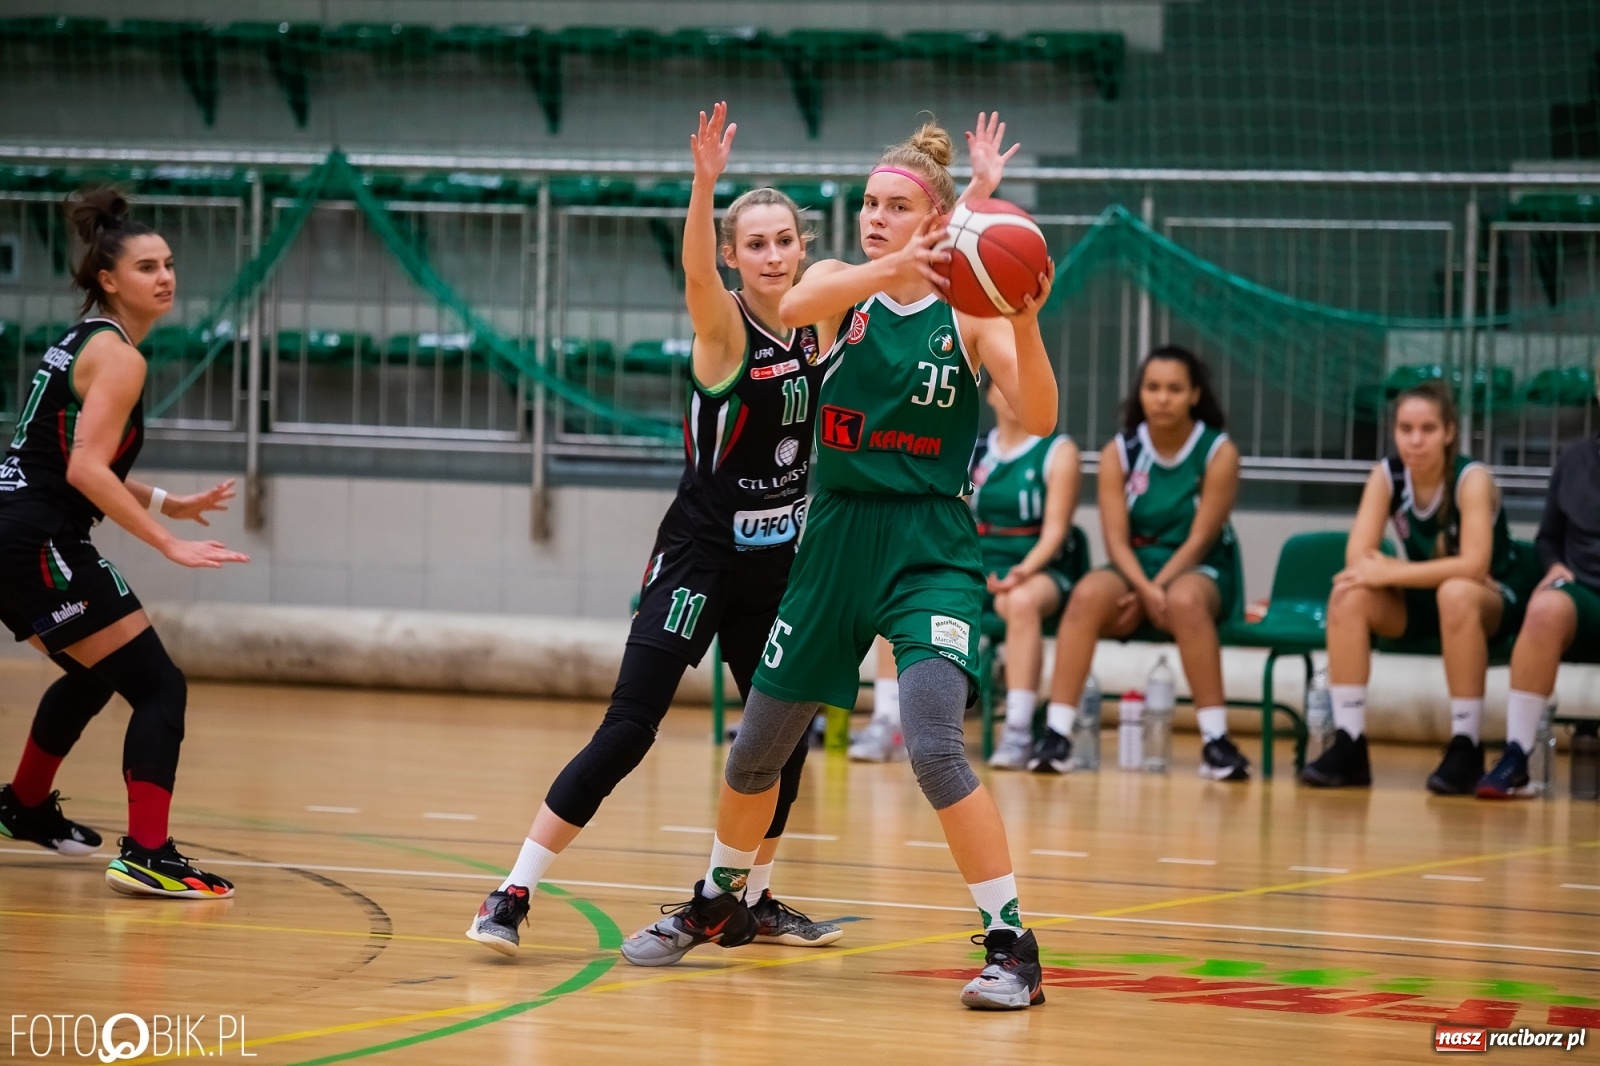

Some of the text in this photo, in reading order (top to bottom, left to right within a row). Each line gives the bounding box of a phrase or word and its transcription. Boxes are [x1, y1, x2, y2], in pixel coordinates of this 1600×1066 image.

[782, 376, 809, 426] 11
[911, 361, 960, 408] 35
[10, 369, 52, 449] 7
[869, 430, 942, 456] KAMAN
[738, 478, 768, 489] CTL
[98, 559, 129, 597] 7
[51, 601, 86, 624] Haldex
[663, 587, 707, 640] 11
[761, 615, 793, 669] 5
